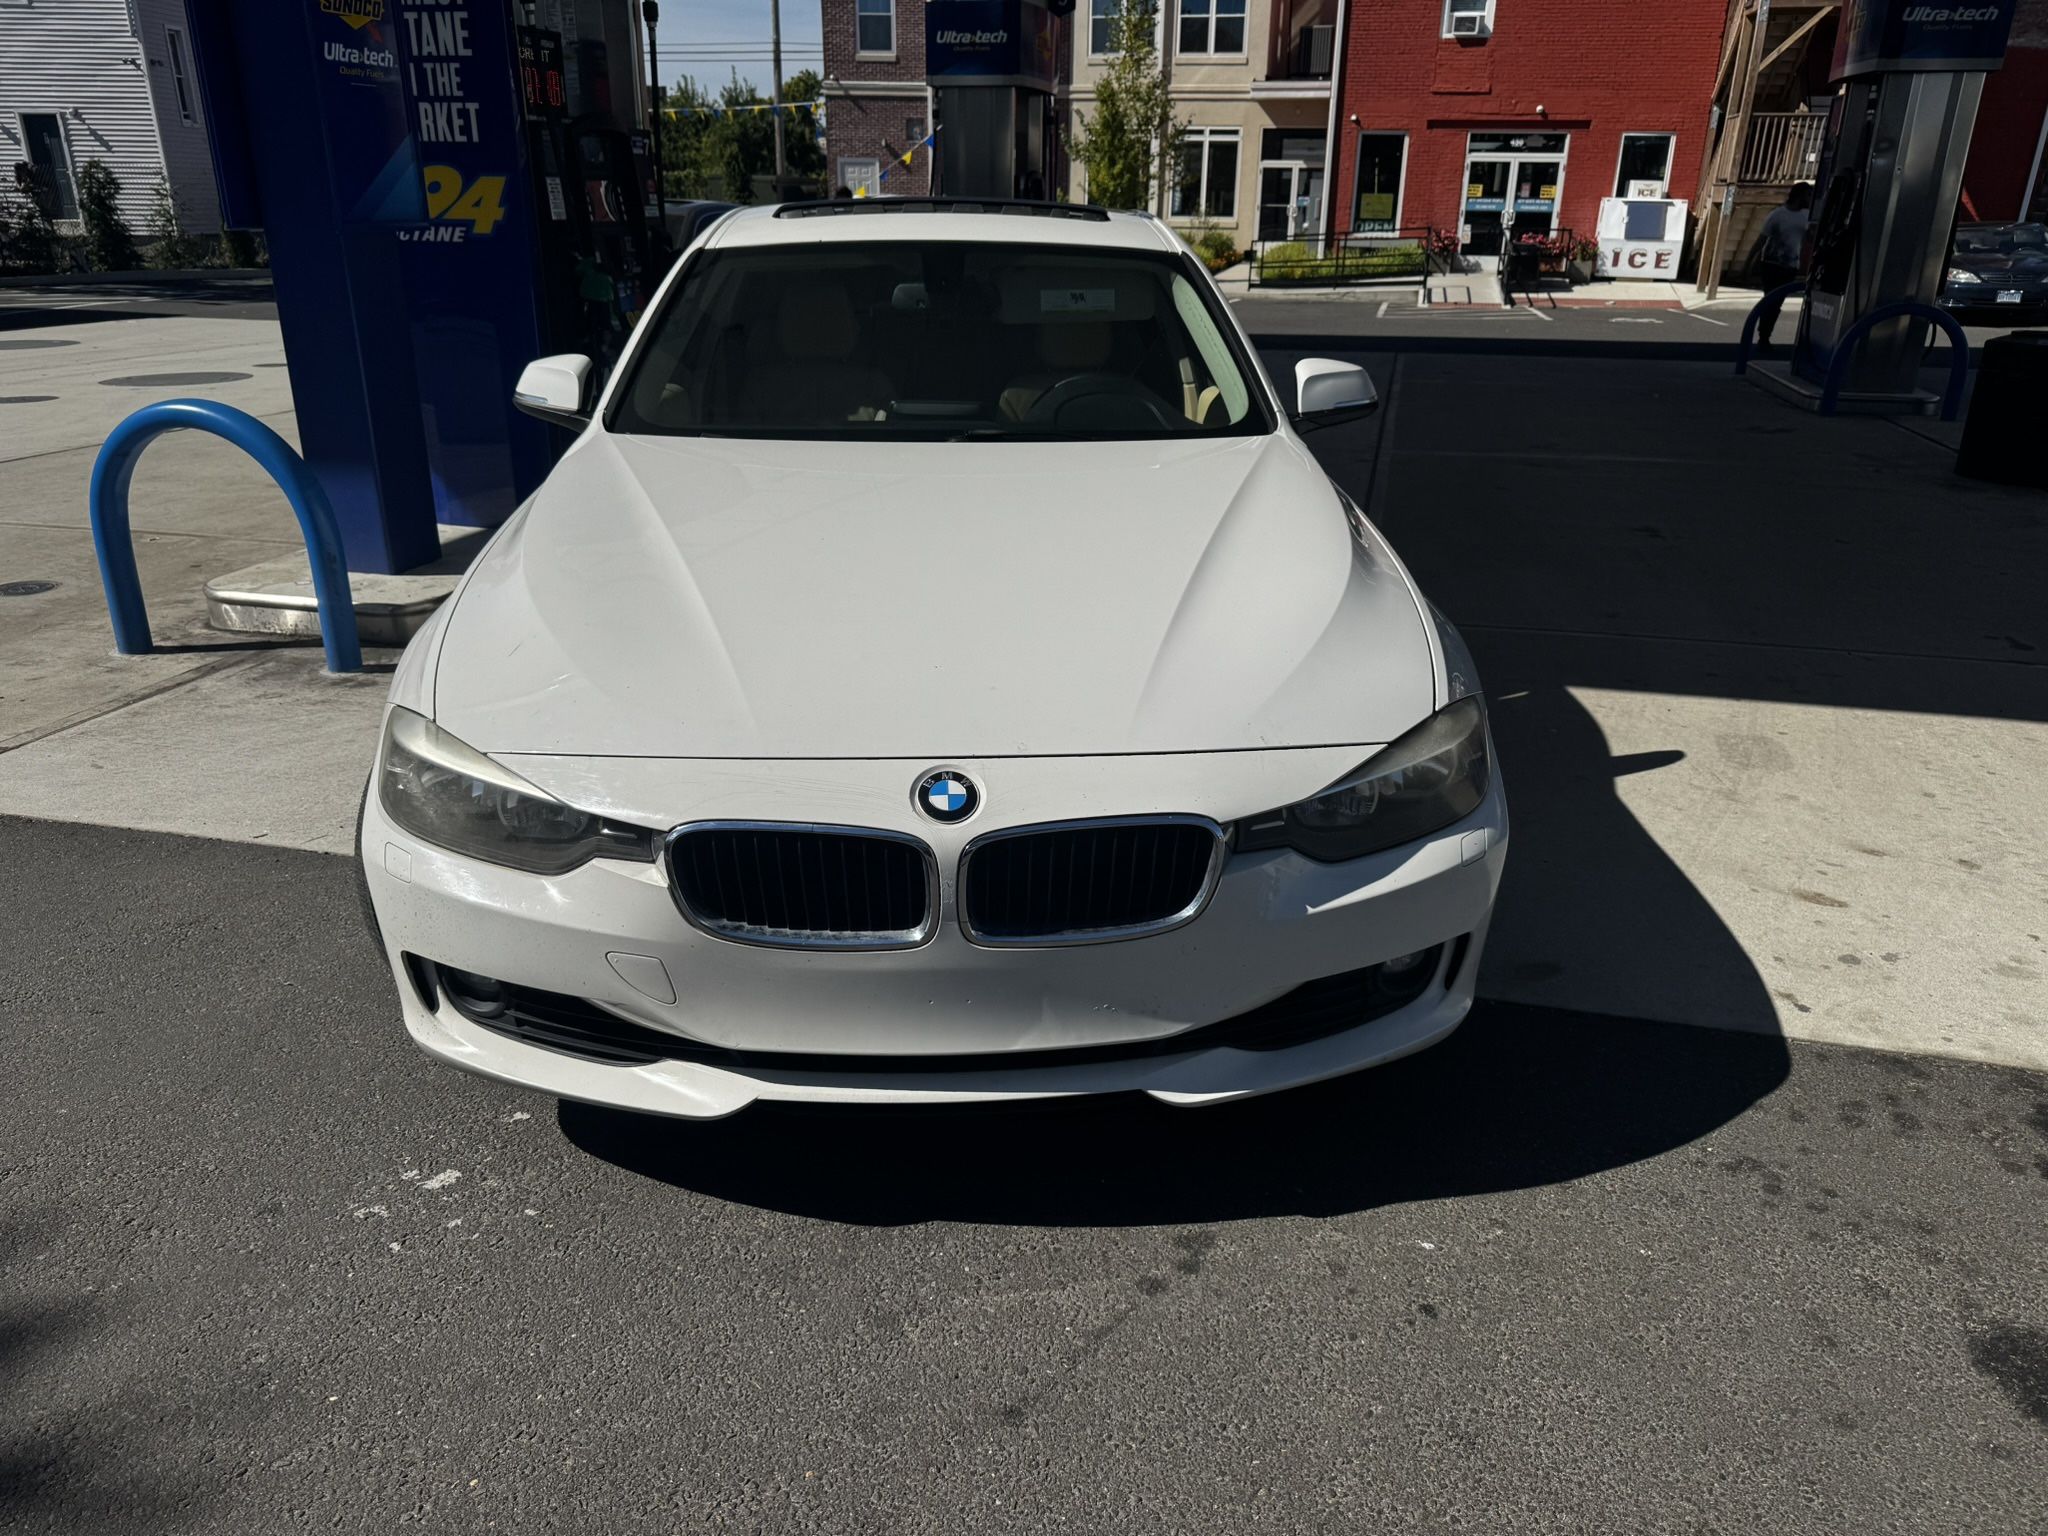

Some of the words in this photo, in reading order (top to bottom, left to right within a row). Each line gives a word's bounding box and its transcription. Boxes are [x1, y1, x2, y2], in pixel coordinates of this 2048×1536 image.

[322, 0, 382, 18] SUNOCO
[403, 11, 473, 57] TANE
[339, 66, 366, 78] Quality
[423, 62, 465, 97] THE
[418, 102, 480, 143] RKET
[1637, 188, 1657, 197] ICE
[1611, 247, 1673, 269] ICE
[923, 772, 972, 788] BMW
